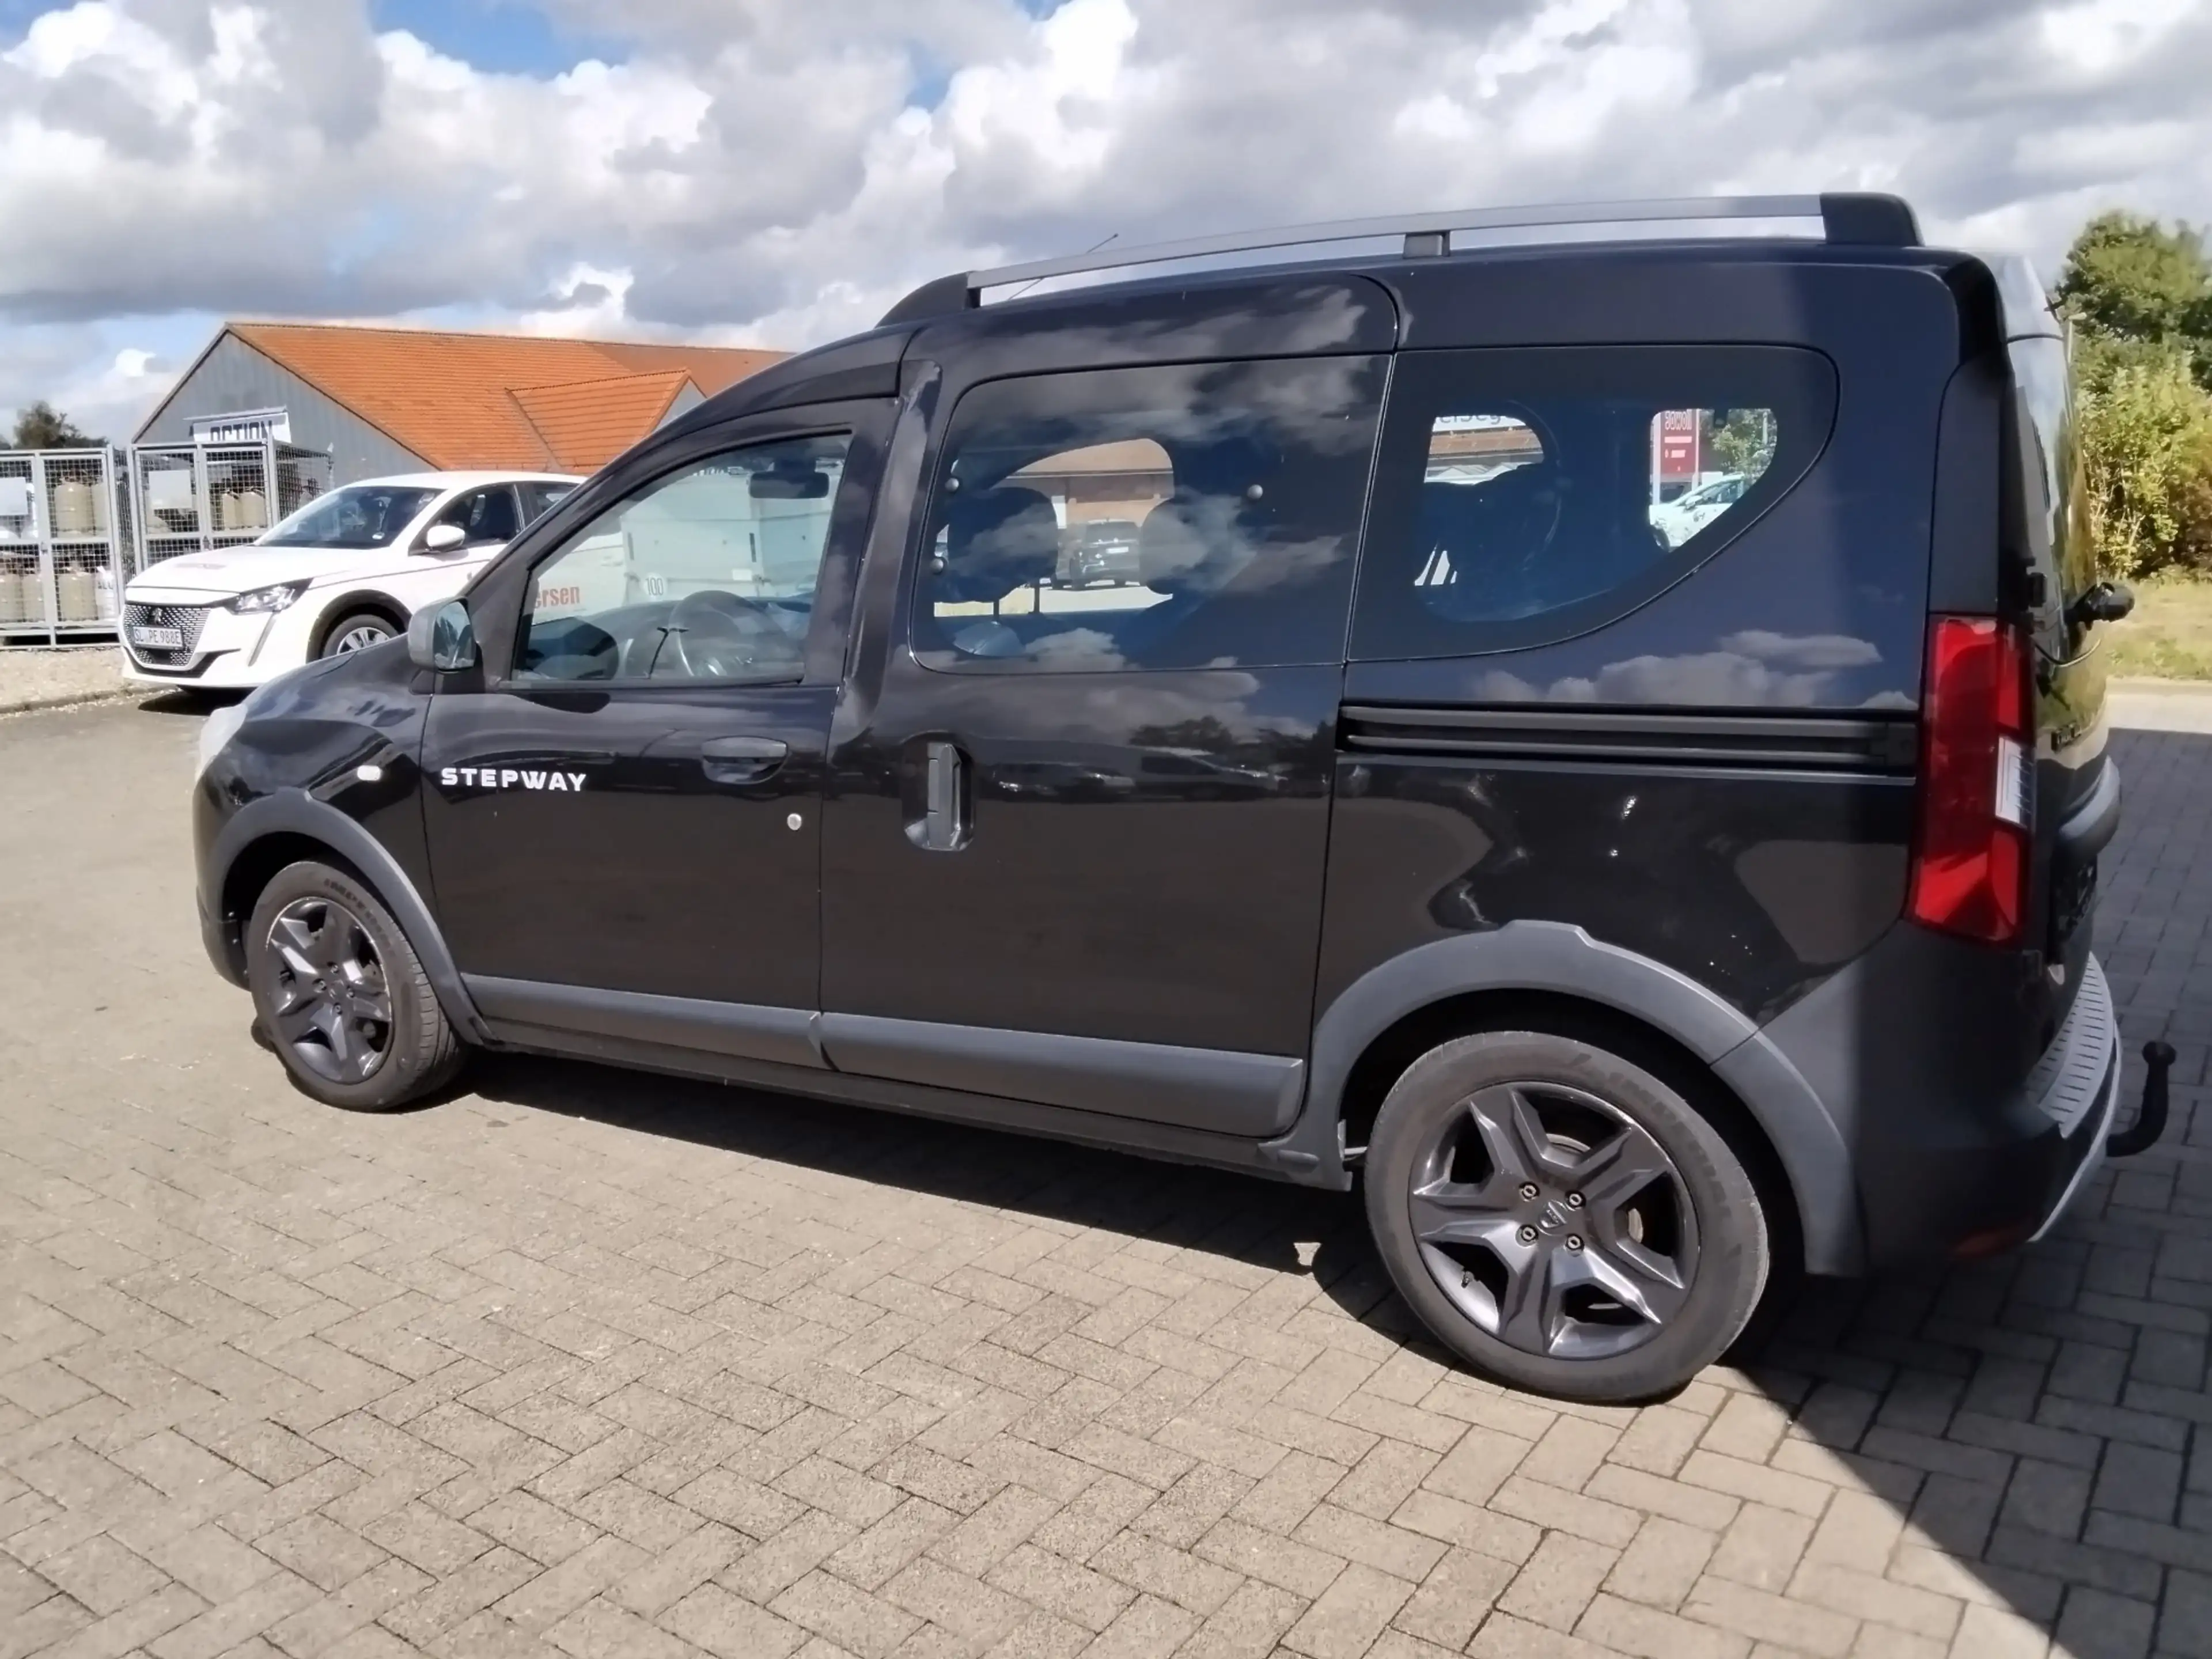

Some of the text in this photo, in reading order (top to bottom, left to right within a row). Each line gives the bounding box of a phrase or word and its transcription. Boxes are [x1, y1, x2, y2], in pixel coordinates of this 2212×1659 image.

[646, 577, 664, 596] 100
[148, 629, 159, 643] PE
[441, 767, 586, 791] STEPWAY
